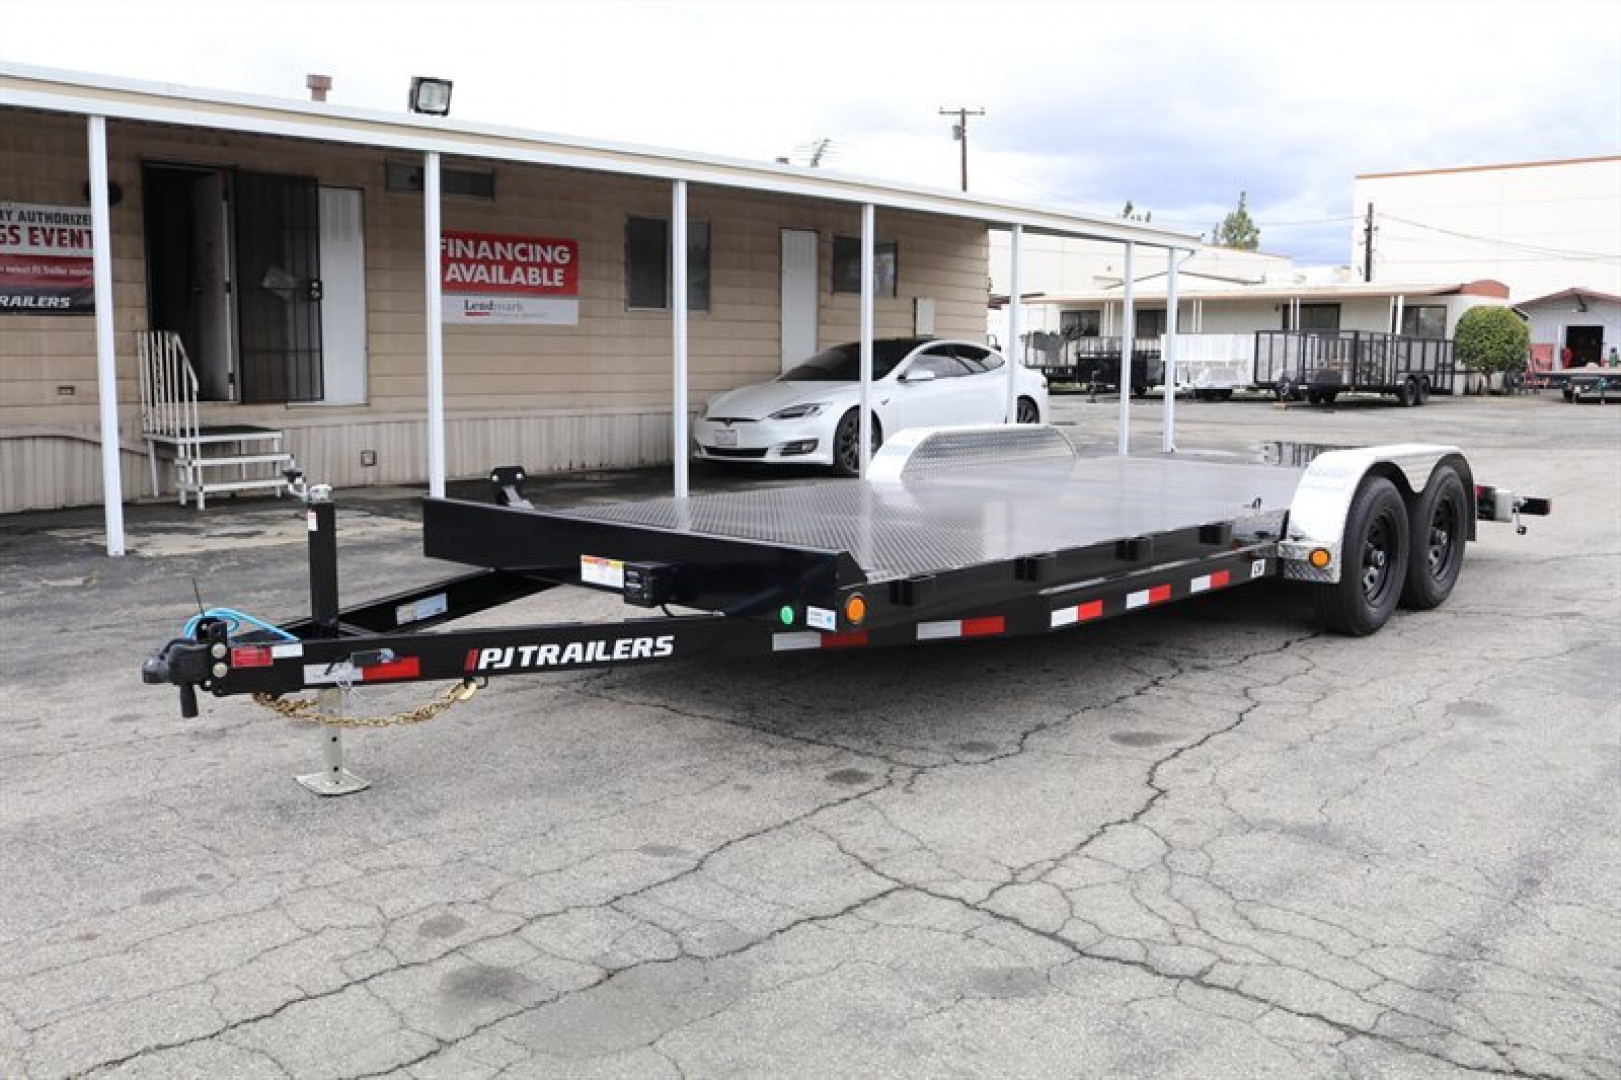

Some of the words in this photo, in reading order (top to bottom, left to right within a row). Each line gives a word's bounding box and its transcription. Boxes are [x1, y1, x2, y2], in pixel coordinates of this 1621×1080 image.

[28, 226, 94, 249] EVENT
[440, 237, 571, 264] FINANCING
[446, 263, 564, 287] AVAILABLE
[478, 647, 514, 670] PJ
[518, 635, 675, 668] TRAILERS
